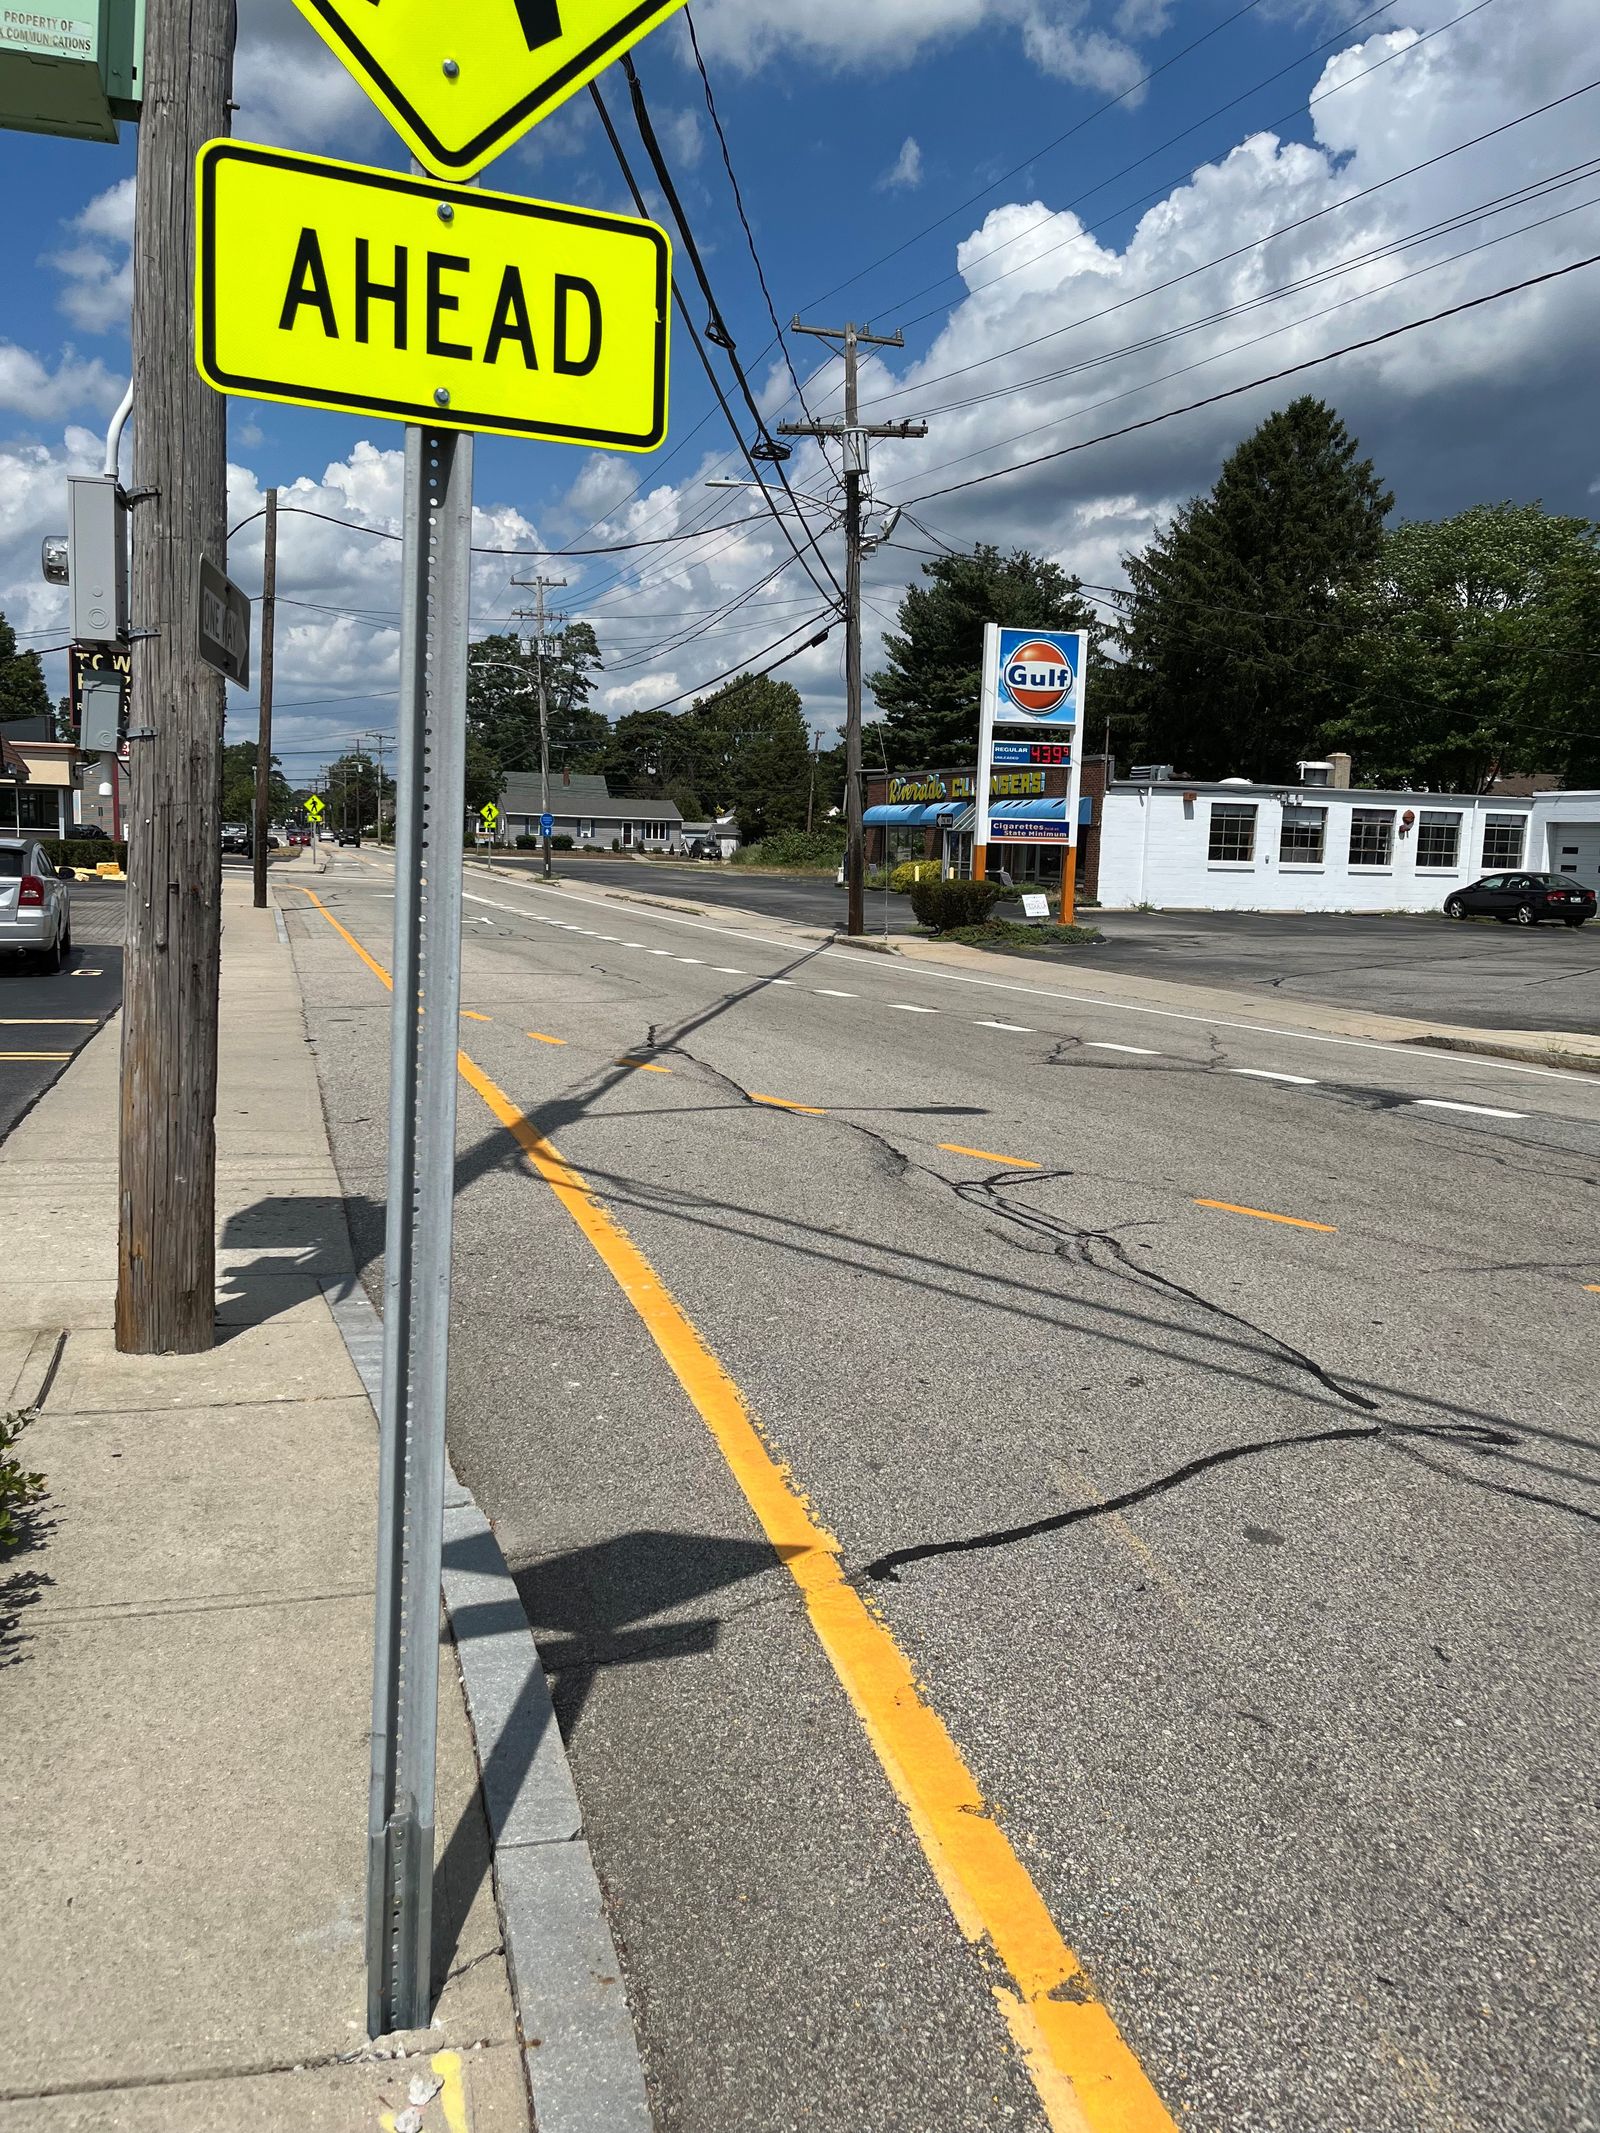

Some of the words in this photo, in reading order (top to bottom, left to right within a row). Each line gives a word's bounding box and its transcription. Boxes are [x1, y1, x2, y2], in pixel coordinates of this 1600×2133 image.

[4, 11, 58, 30] PROPERTY
[60, 20, 74, 32] OF
[7, 28, 91, 51] COMMUNCATIONS
[279, 227, 603, 377] AHEAD
[204, 593, 220, 640] ONE
[222, 606, 238, 651] WAY
[1008, 665, 1068, 687] Gulf
[889, 773, 946, 804] Riverside
[951, 772, 1045, 796] CLNSERS
[993, 822, 1044, 831] Cigarettes
